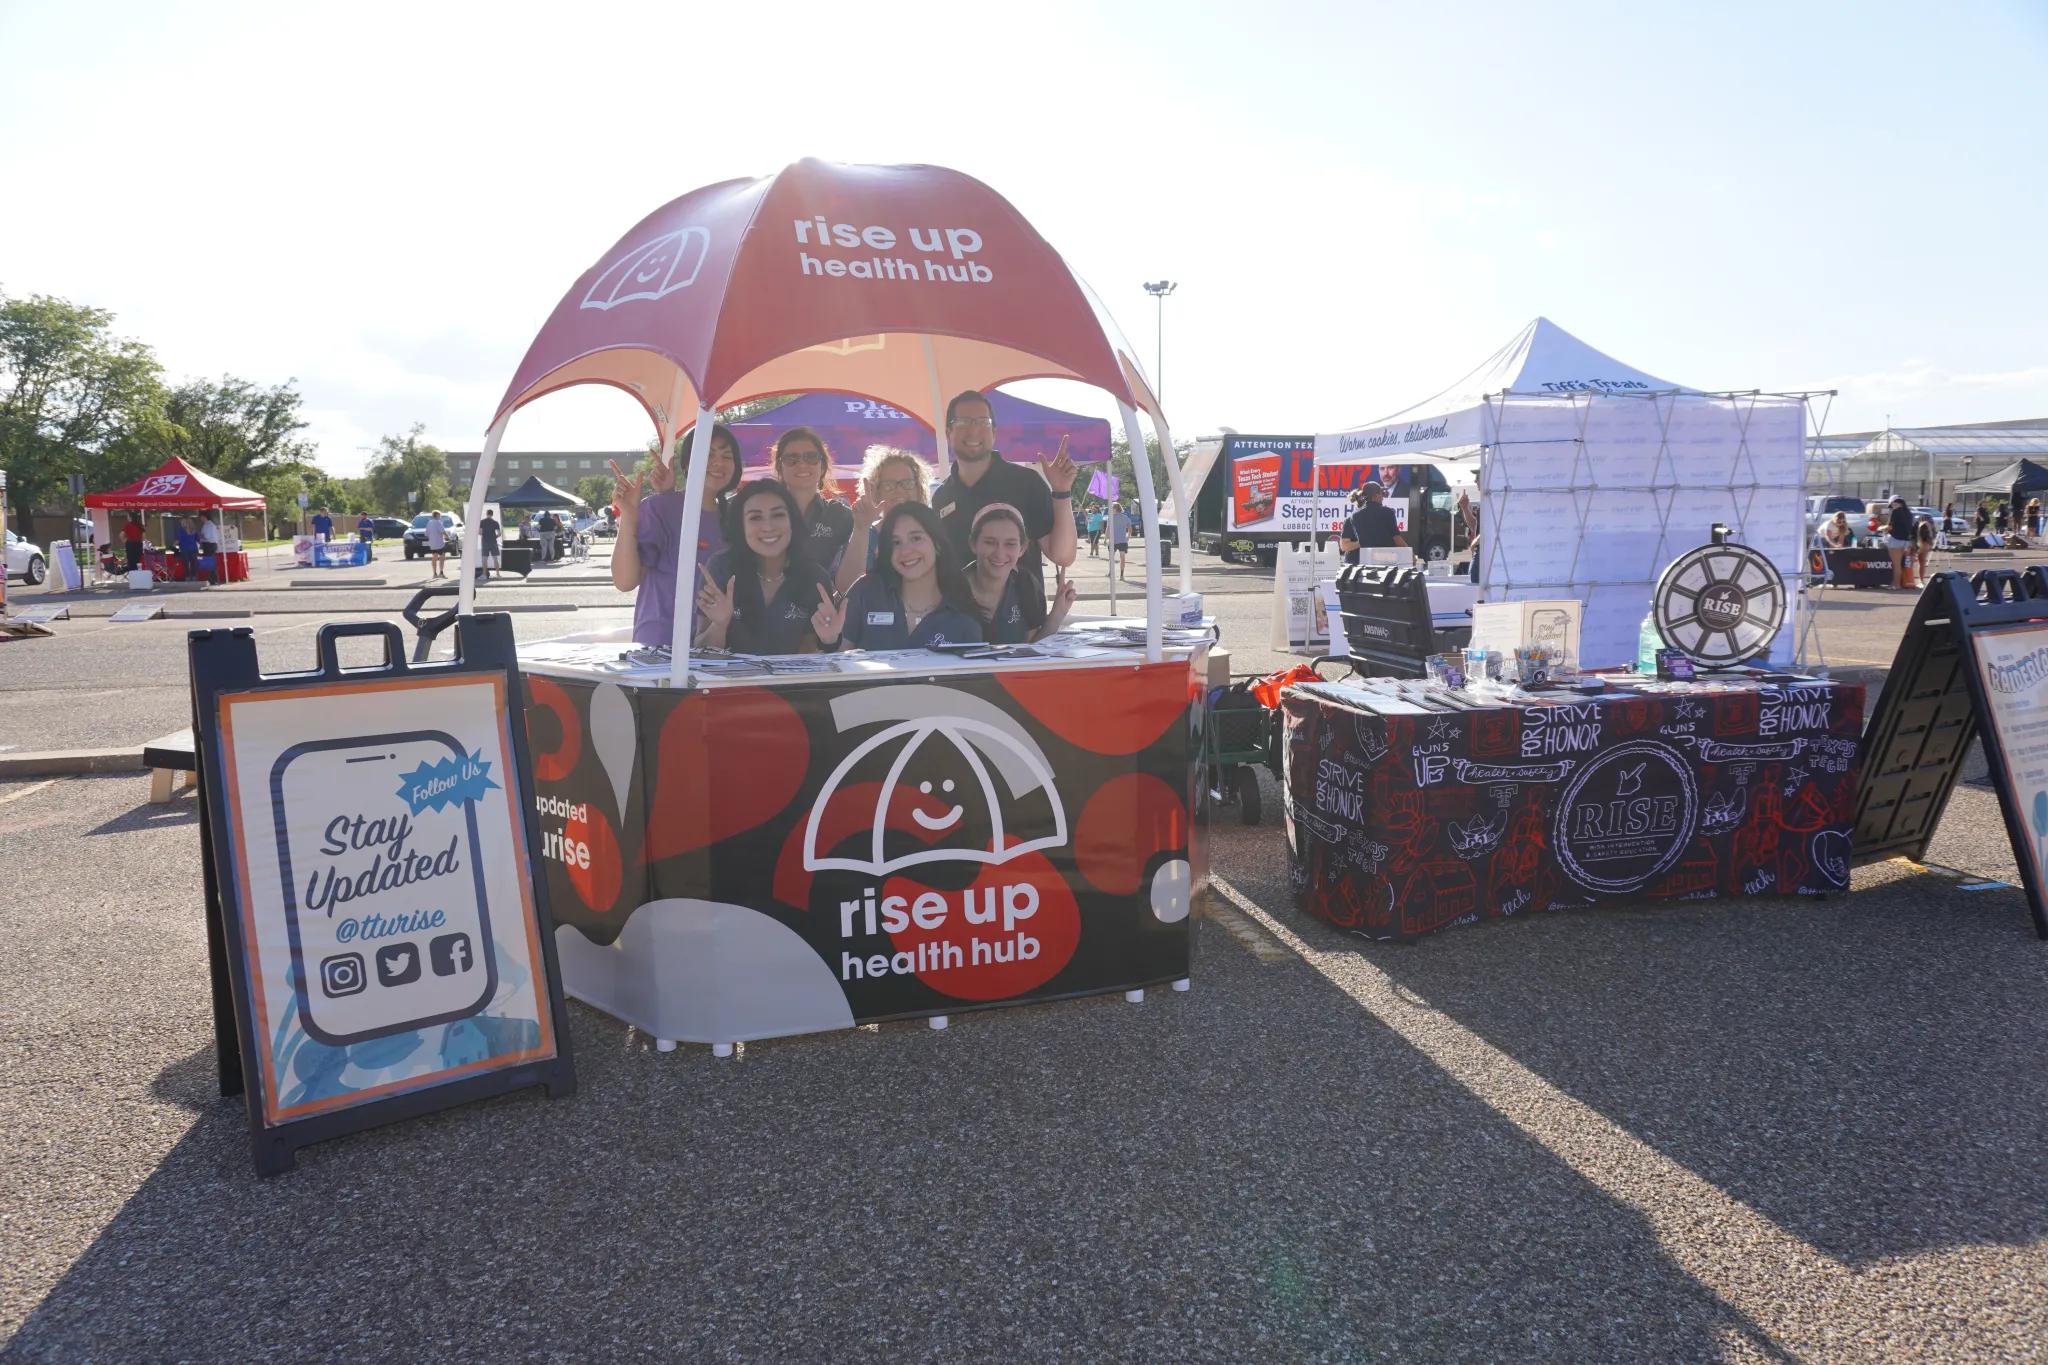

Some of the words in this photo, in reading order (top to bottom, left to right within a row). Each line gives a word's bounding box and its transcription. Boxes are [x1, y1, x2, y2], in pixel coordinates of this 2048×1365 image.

[793, 216, 897, 250] rise
[908, 228, 983, 260] up
[800, 252, 920, 281] health
[923, 259, 993, 283] hub
[1541, 380, 1588, 392] Tiff's
[1590, 378, 1648, 391] Treats
[1234, 441, 1292, 449] ATTENTION
[1339, 435, 1366, 453] Warm
[1367, 428, 1401, 449] cookies,
[1404, 418, 1449, 444] delivered.
[1290, 489, 1301, 497] He
[1325, 489, 1338, 497] the
[1703, 597, 1742, 616] RISE
[1524, 704, 1602, 724] STRIVE
[1660, 722, 1695, 735] GUNS
[1760, 705, 1780, 736] FOR
[1779, 702, 1831, 732] HONOR
[1412, 742, 1450, 757] GUNS
[1521, 725, 1544, 758] FOR
[1544, 723, 1602, 755] HONOR
[1809, 734, 1857, 757] TEXAS
[1319, 760, 1364, 792] STRIVE
[1809, 755, 1848, 773] TECH
[412, 774, 458, 804] Follow
[461, 763, 482, 781] Us
[1316, 779, 1329, 811] FOR
[1327, 784, 1365, 825] HONOR
[1573, 796, 1679, 839] RISE
[320, 814, 413, 861] Stay
[305, 835, 459, 918] Updated
[1744, 869, 1776, 894] tech
[840, 887, 949, 938] rise
[963, 882, 1040, 931] up
[1502, 889, 1531, 916] tech
[336, 908, 446, 943] @tturise
[842, 940, 963, 981] health
[971, 932, 1041, 966] hub
